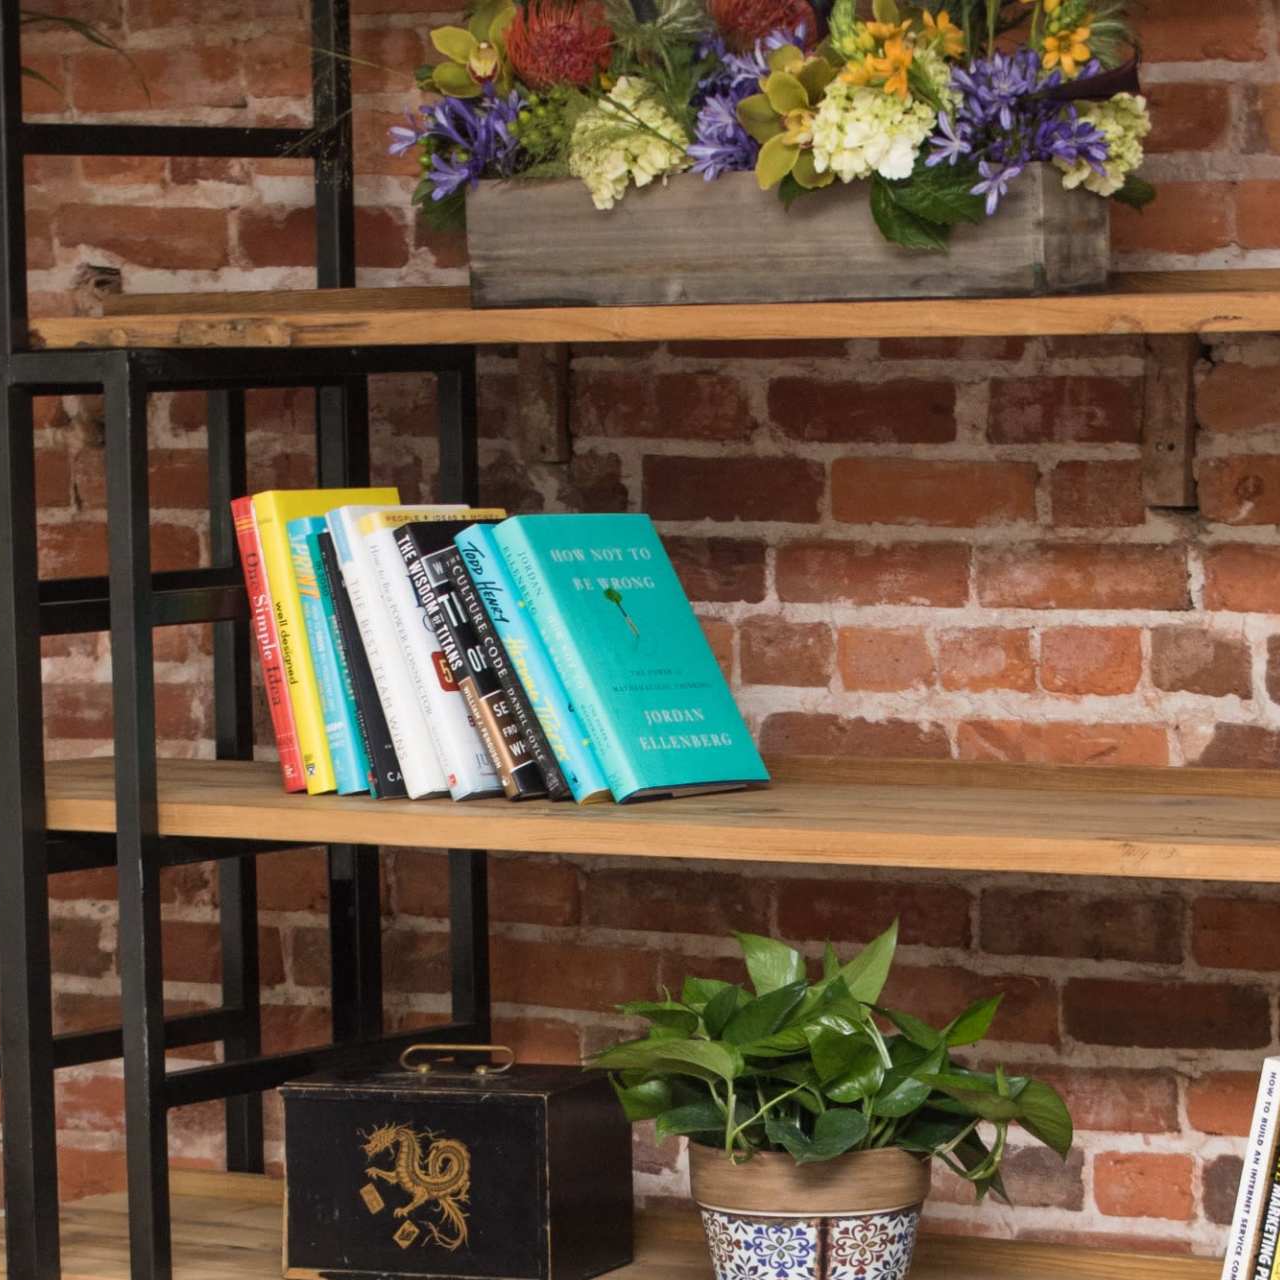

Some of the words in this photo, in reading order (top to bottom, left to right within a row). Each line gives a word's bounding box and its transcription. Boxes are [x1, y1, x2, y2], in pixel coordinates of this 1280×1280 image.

[398, 534, 417, 562] THE
[462, 541, 485, 576] TODD
[550, 548, 586, 562] HOW
[590, 548, 623, 561] NOT
[631, 547, 652, 560] TO
[408, 561, 440, 616] WISDOM
[518, 552, 544, 597] JORDAN
[572, 577, 594, 591] BE
[597, 576, 655, 589] WRONG
[275, 601, 288, 628] well
[431, 613, 445, 625] OF
[452, 564, 488, 633] CULTURE
[484, 636, 509, 679] CODE
[253, 593, 276, 660] Simple
[267, 665, 282, 706] Idea
[280, 628, 299, 685] designed
[436, 623, 464, 671] TITANS
[439, 658, 454, 683] 5
[360, 618, 378, 657] BEST
[375, 666, 394, 708] TEAM
[389, 714, 409, 761] WINS
[507, 687, 527, 727] DANIEL
[526, 728, 546, 762] COYLE
[643, 707, 705, 725] JORDAN
[481, 727, 503, 769] FERGUSON
[639, 733, 733, 751] ELLENBERG
[1267, 1072, 1277, 1098] HOW
[1263, 1101, 1272, 1114] TO
[1257, 1116, 1269, 1147] BUILD
[1253, 1150, 1262, 1166] AN
[1244, 1167, 1259, 1215] INTERNET
[1235, 1217, 1247, 1257] SERVICE
